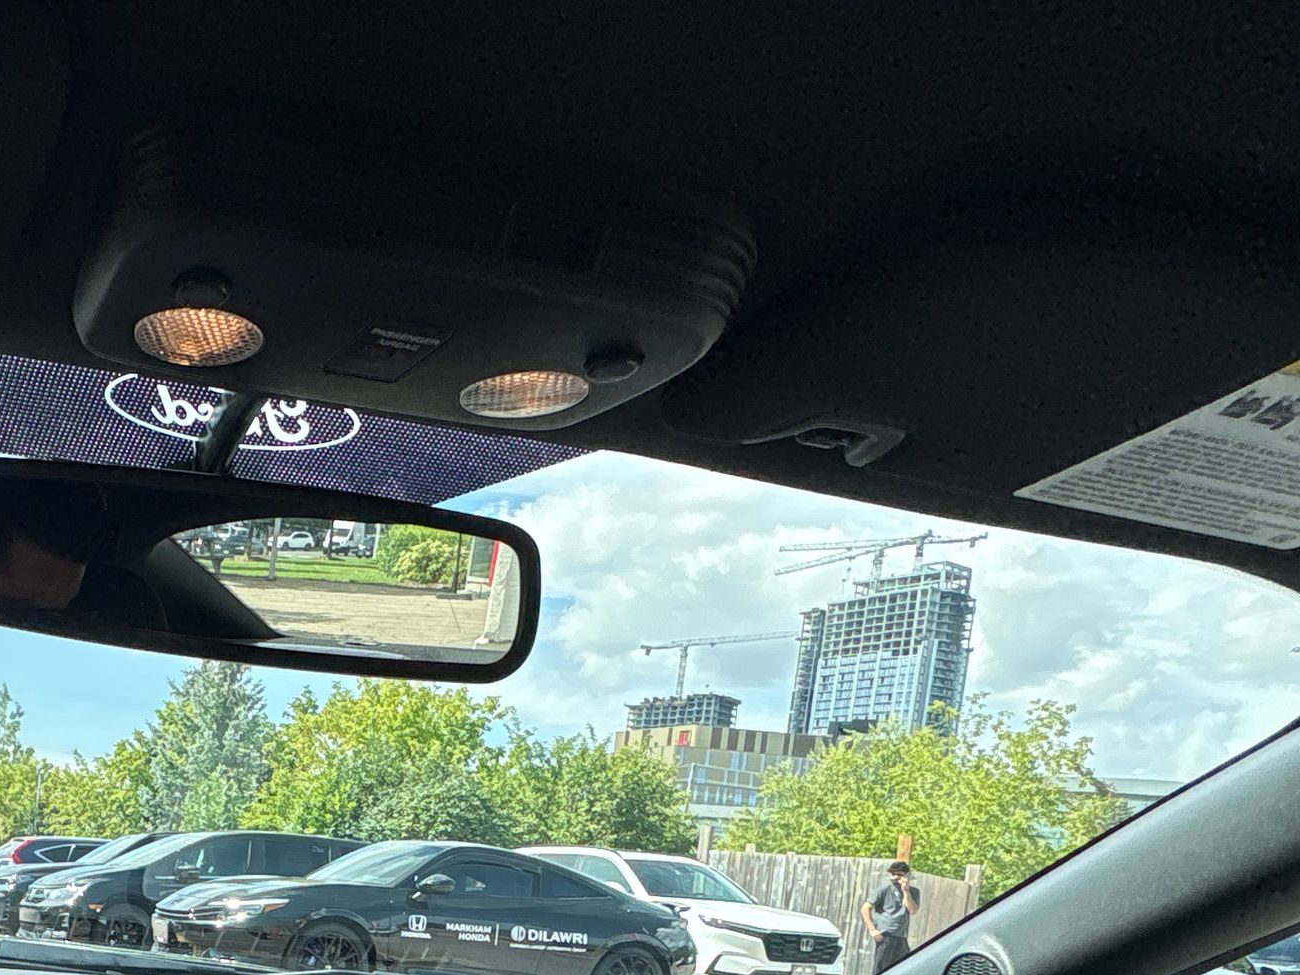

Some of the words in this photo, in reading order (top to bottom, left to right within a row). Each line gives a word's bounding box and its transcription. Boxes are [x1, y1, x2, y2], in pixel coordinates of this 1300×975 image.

[445, 922, 492, 934] MARKHAM
[458, 933, 491, 943] HONDA
[527, 929, 588, 945] DILAWRI
